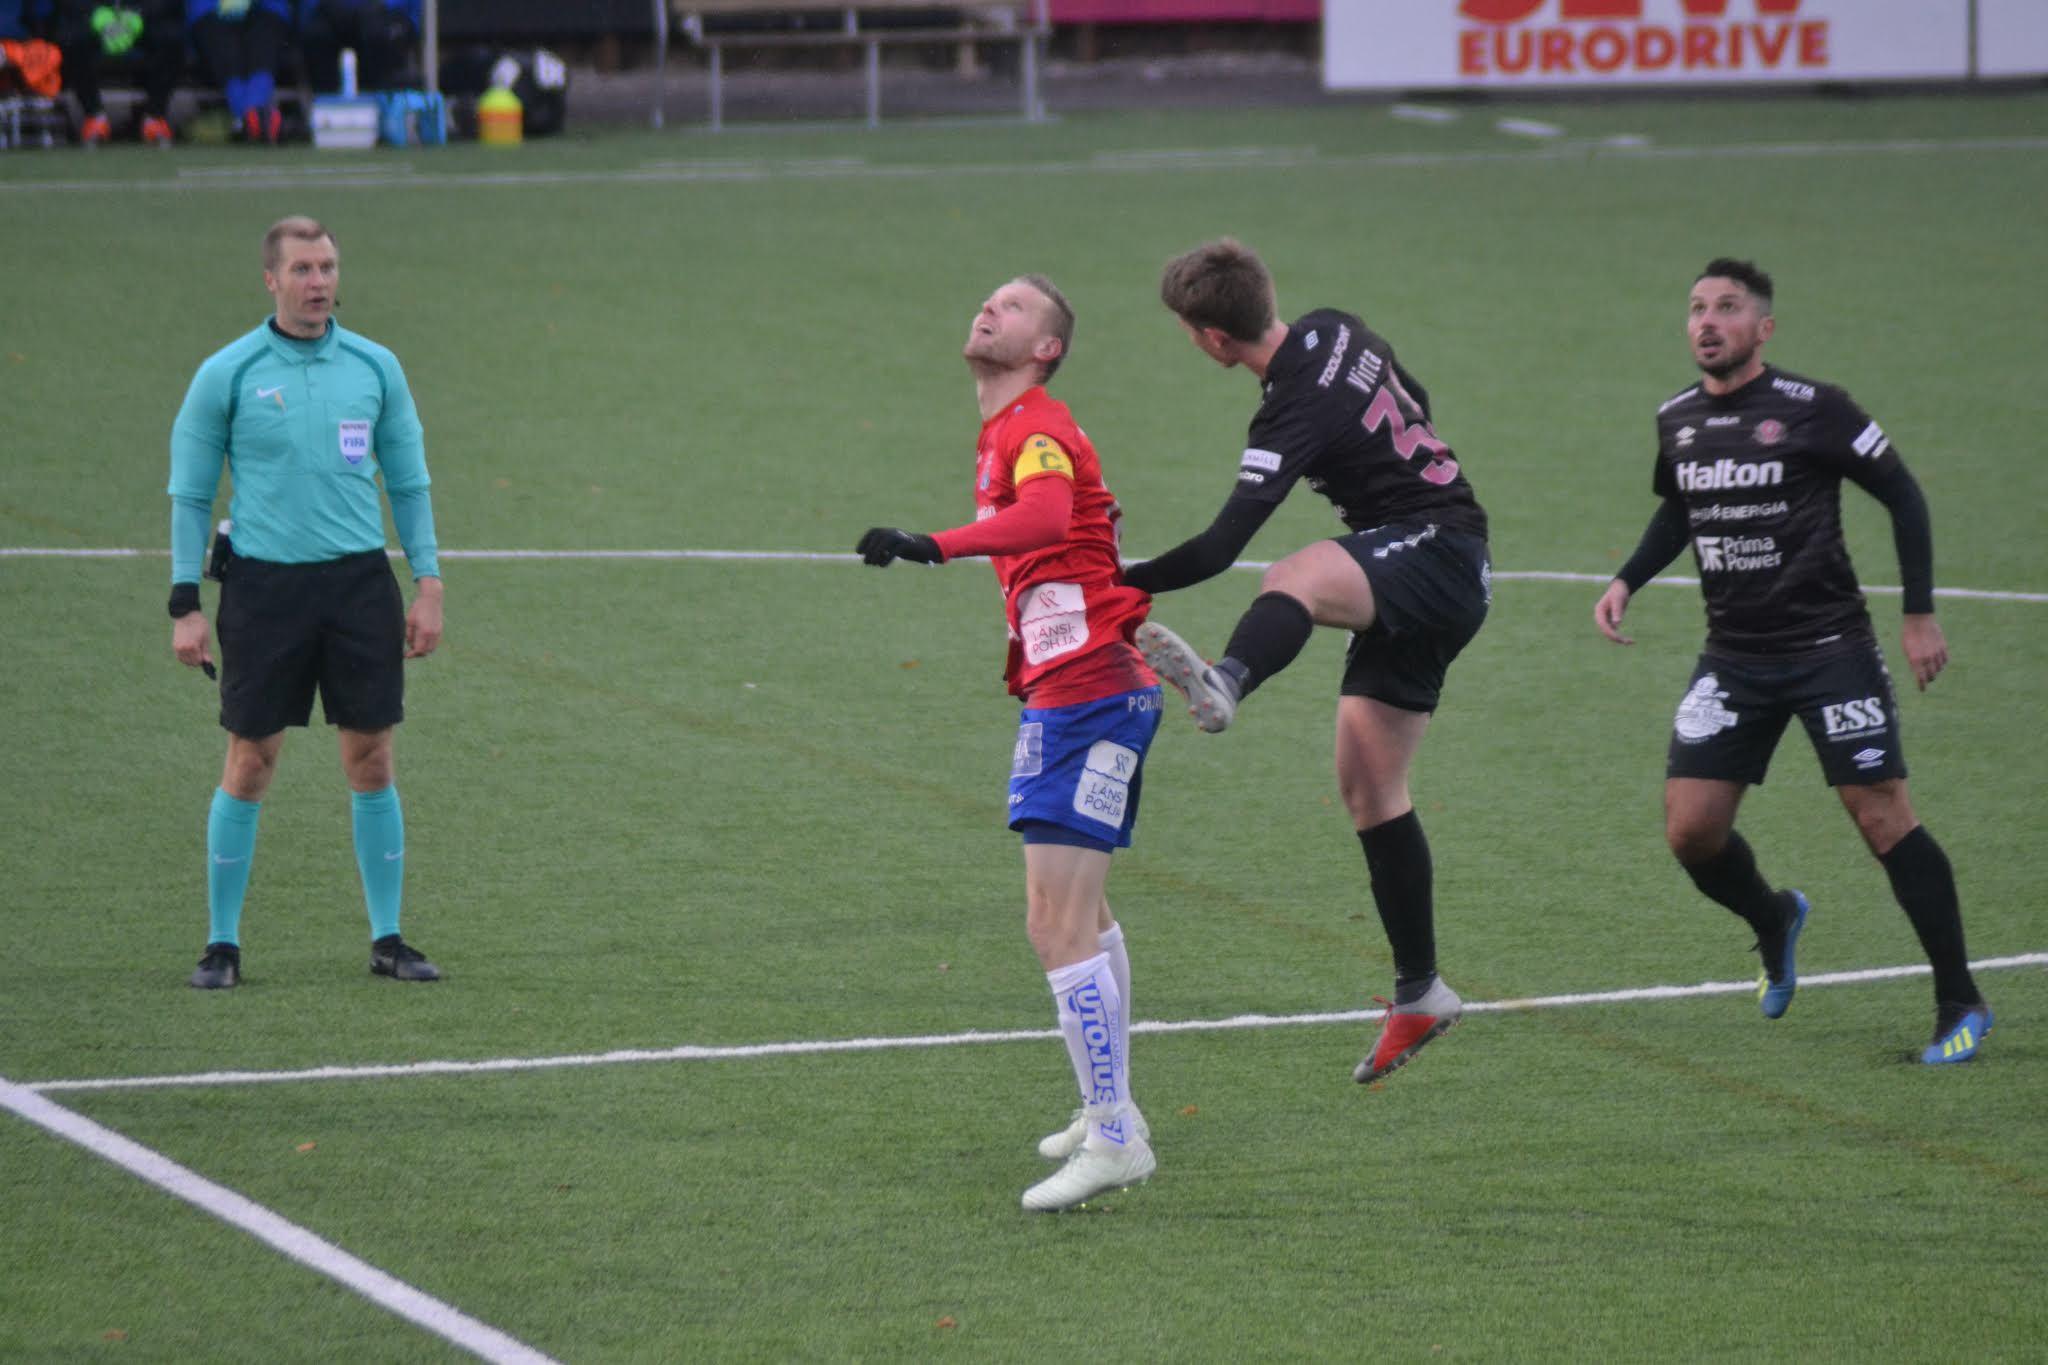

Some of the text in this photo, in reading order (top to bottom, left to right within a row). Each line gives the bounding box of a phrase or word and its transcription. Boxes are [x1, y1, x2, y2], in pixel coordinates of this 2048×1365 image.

[1457, 21, 1829, 76] EURODRIVE
[1346, 349, 1382, 393] Virta
[344, 437, 366, 448] FIFA
[1040, 451, 1064, 470] C
[1676, 458, 1784, 490] Halton
[1722, 500, 1789, 520] ENERGIA
[1723, 535, 1775, 553] Prima
[1726, 551, 1784, 571] Power
[1032, 634, 1079, 655] POHJA
[1821, 697, 1887, 735] ESS
[1091, 781, 1123, 803] LÄNS
